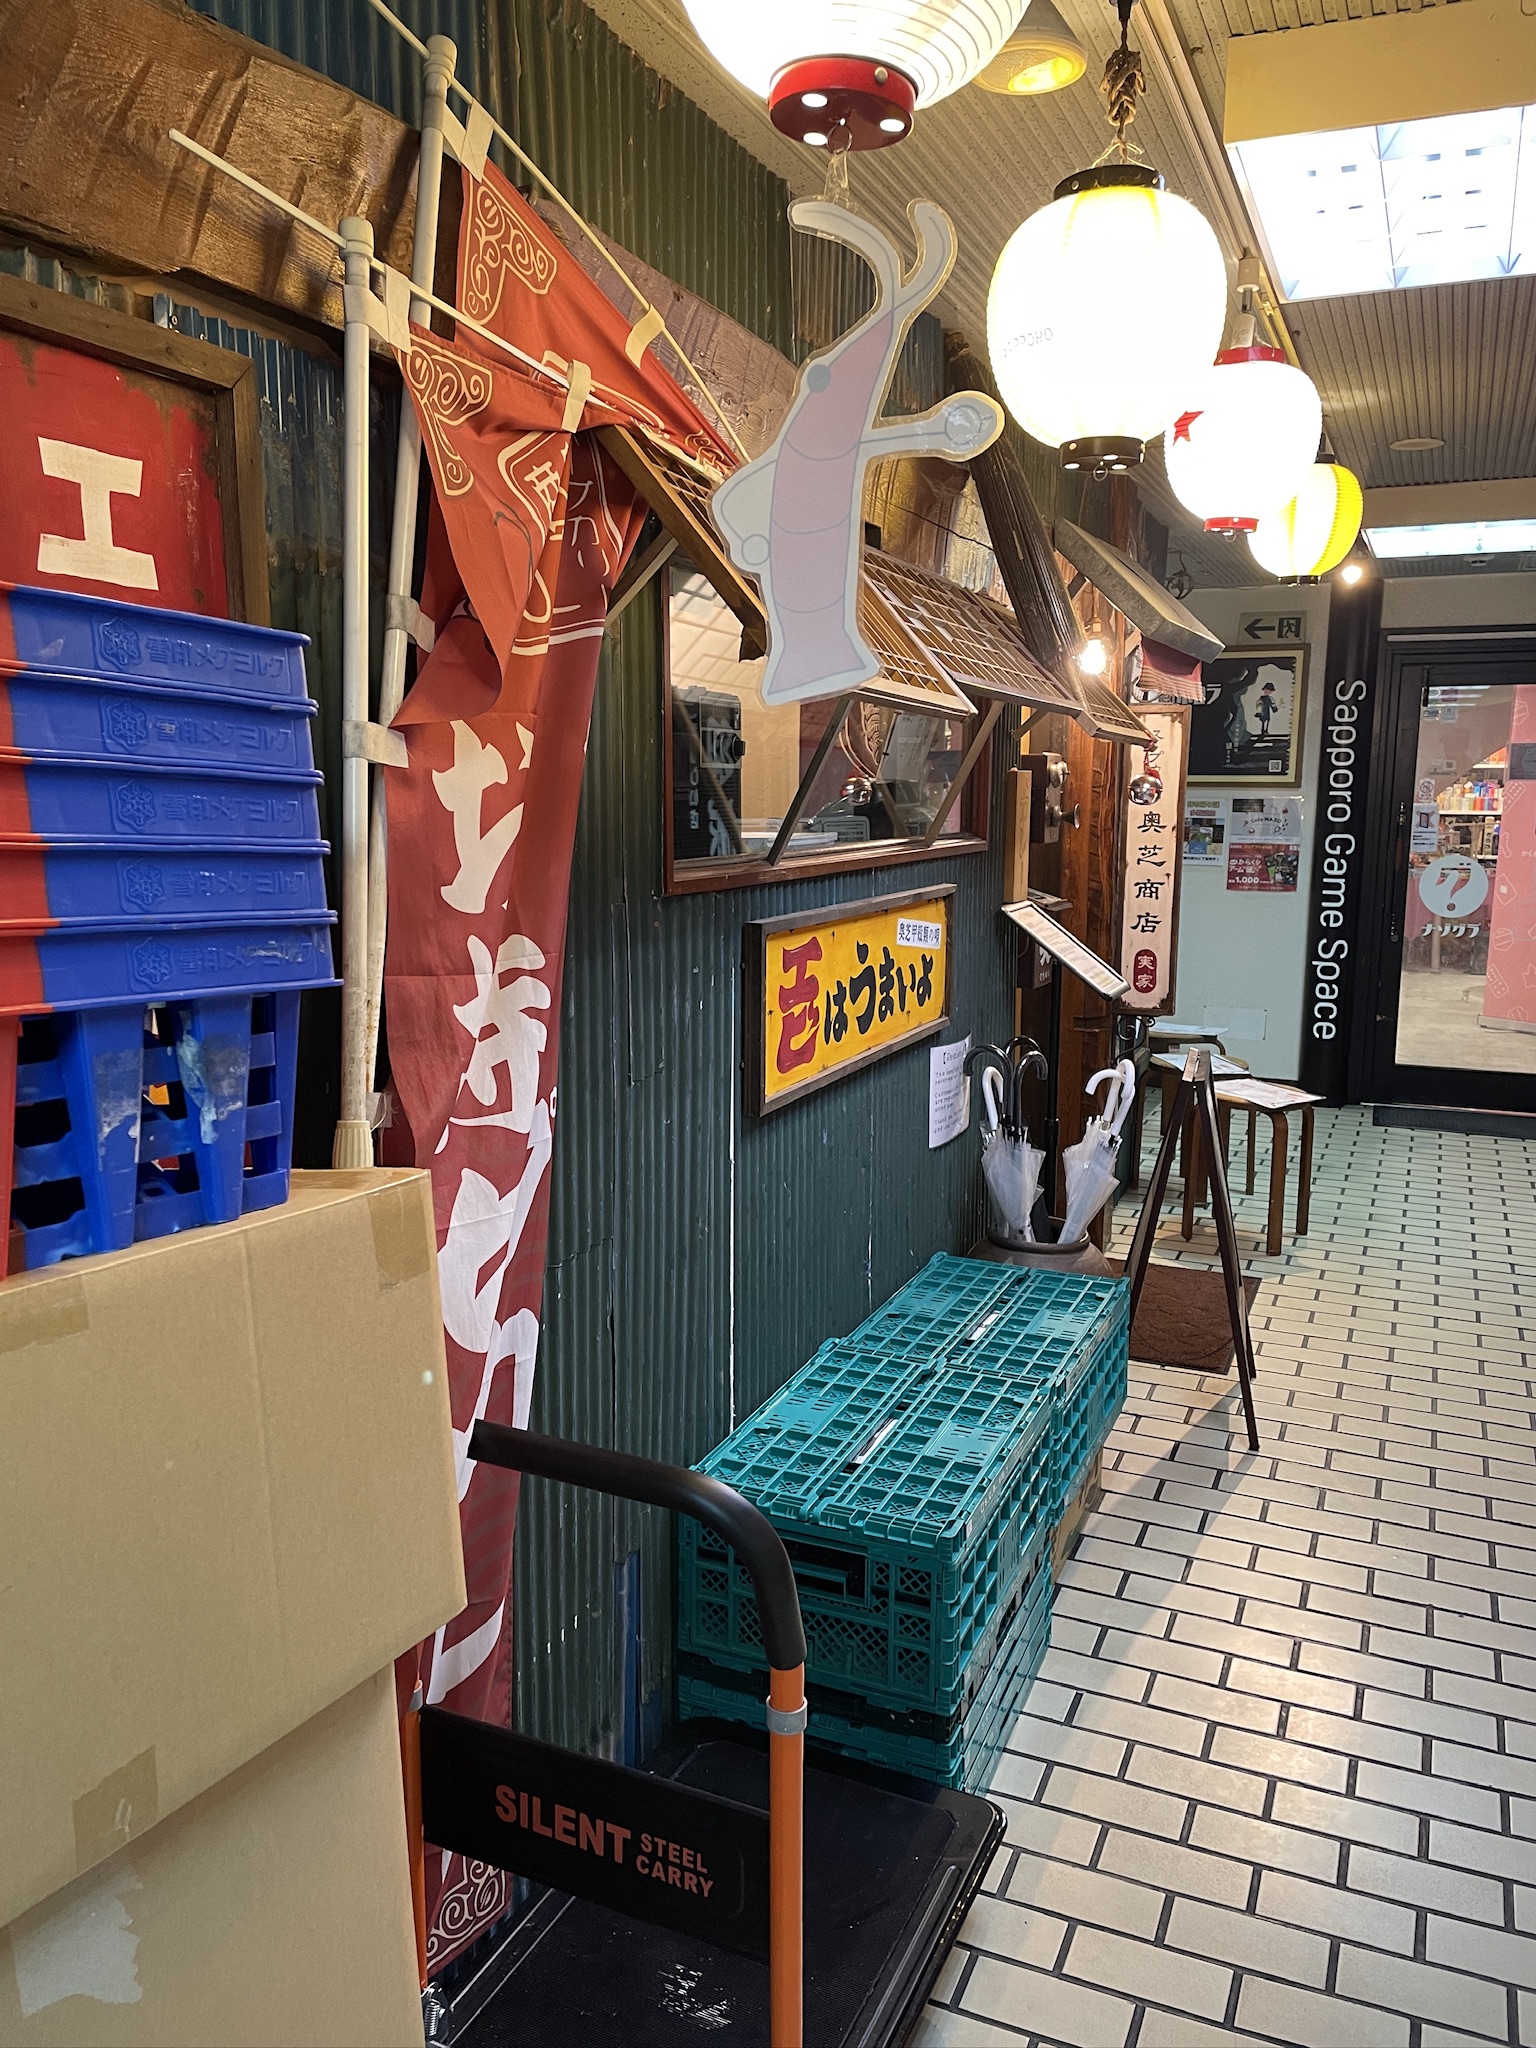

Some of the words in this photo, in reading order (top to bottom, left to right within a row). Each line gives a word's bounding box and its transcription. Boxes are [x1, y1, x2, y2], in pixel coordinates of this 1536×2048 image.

[37, 436, 159, 591] エ
[1326, 679, 1367, 823] Sapporo
[1264, 816, 1282, 824] NAZO
[1130, 810, 1168, 934] 奥芝商店
[1319, 833, 1356, 928] Game
[898, 922, 940, 945] 奥芝甲殻類の唄
[1136, 953, 1156, 991] 実家
[1421, 922, 1482, 939] ナゾグラ
[1311, 938, 1349, 1040] Space
[494, 1784, 632, 1865] SILENT
[640, 1832, 708, 1875] STEEL
[636, 1855, 714, 1899] CARRY
